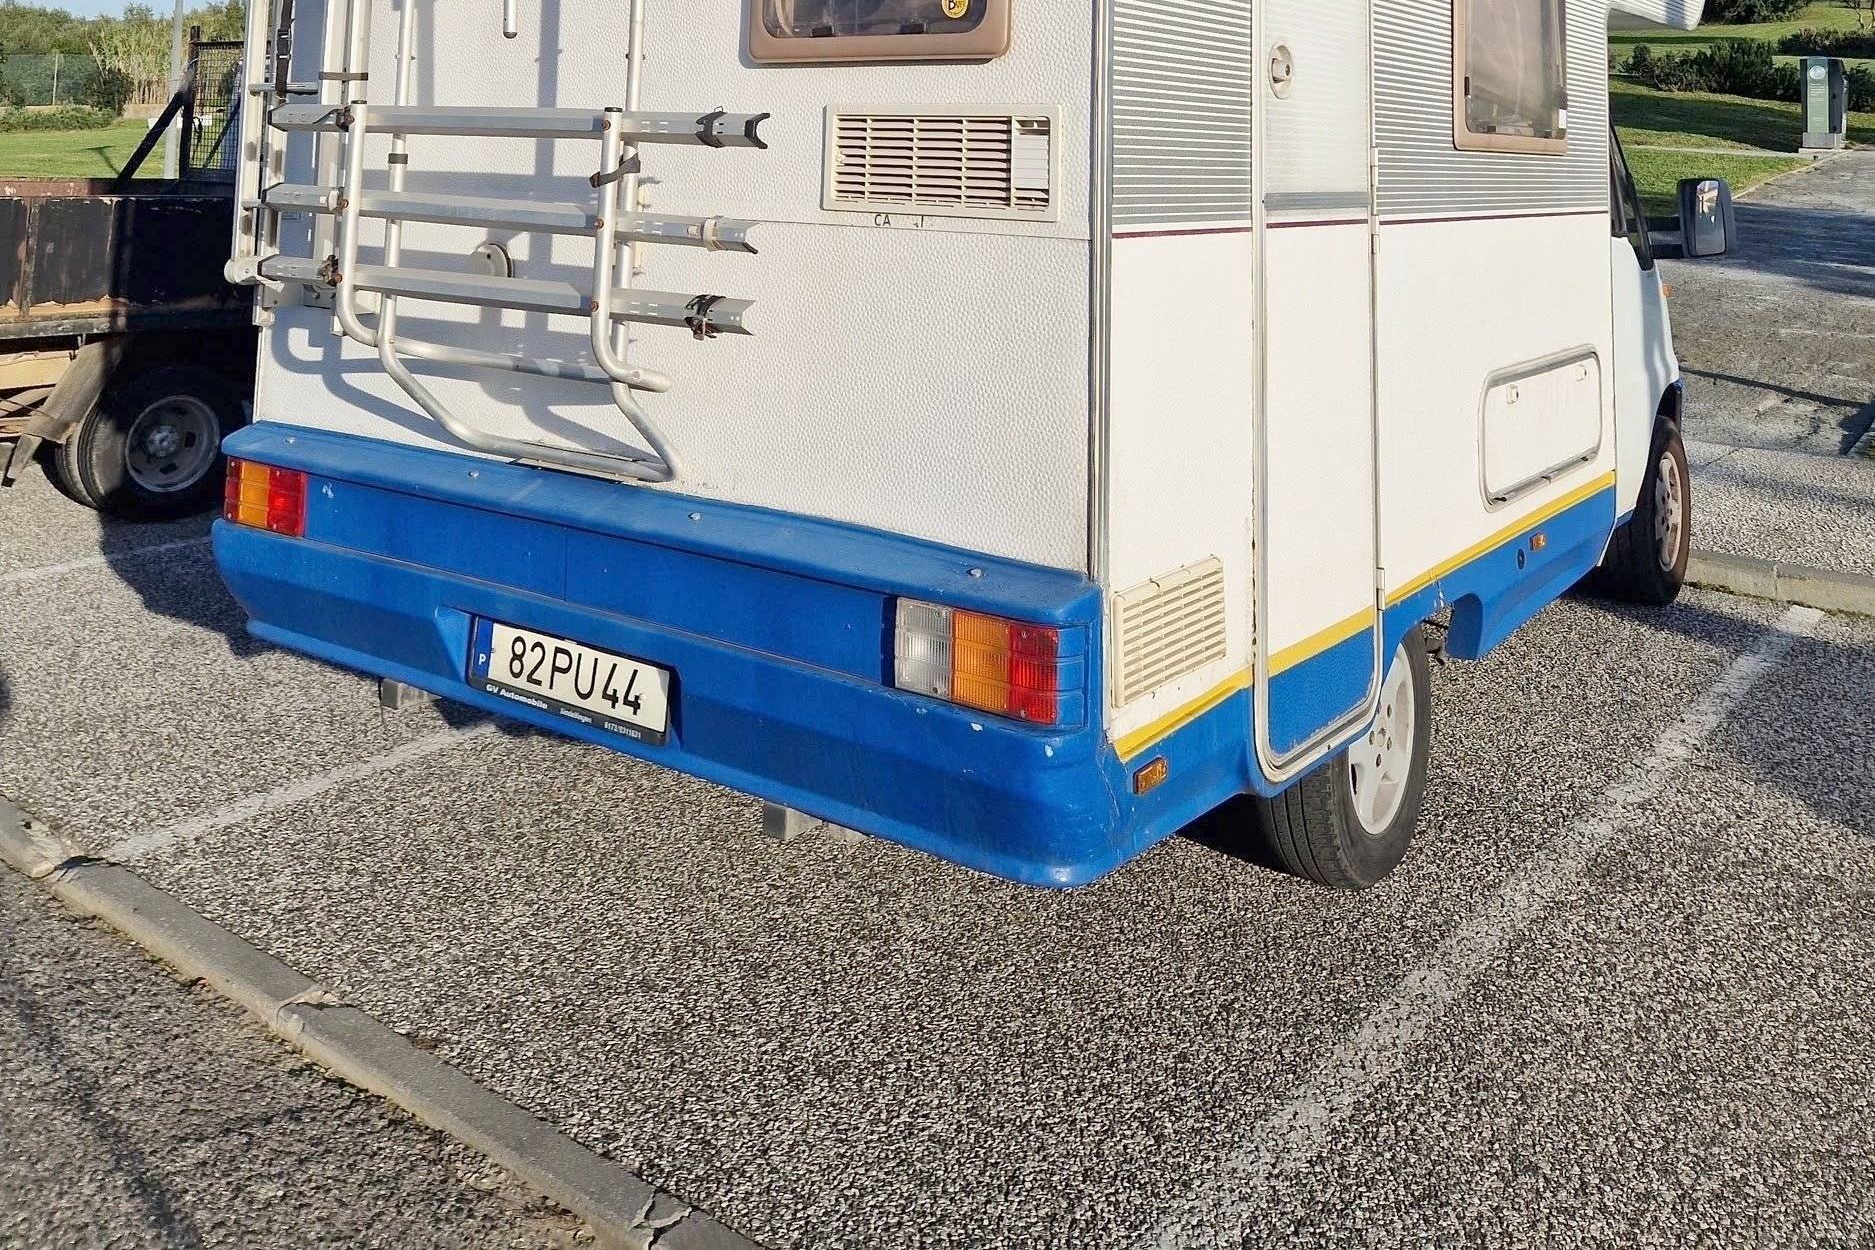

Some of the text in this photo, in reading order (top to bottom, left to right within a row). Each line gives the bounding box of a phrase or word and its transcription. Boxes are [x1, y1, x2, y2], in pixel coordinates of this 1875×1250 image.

[478, 653, 486, 666] P
[509, 636, 641, 715] 82PU44
[500, 688, 548, 710] Automobile
